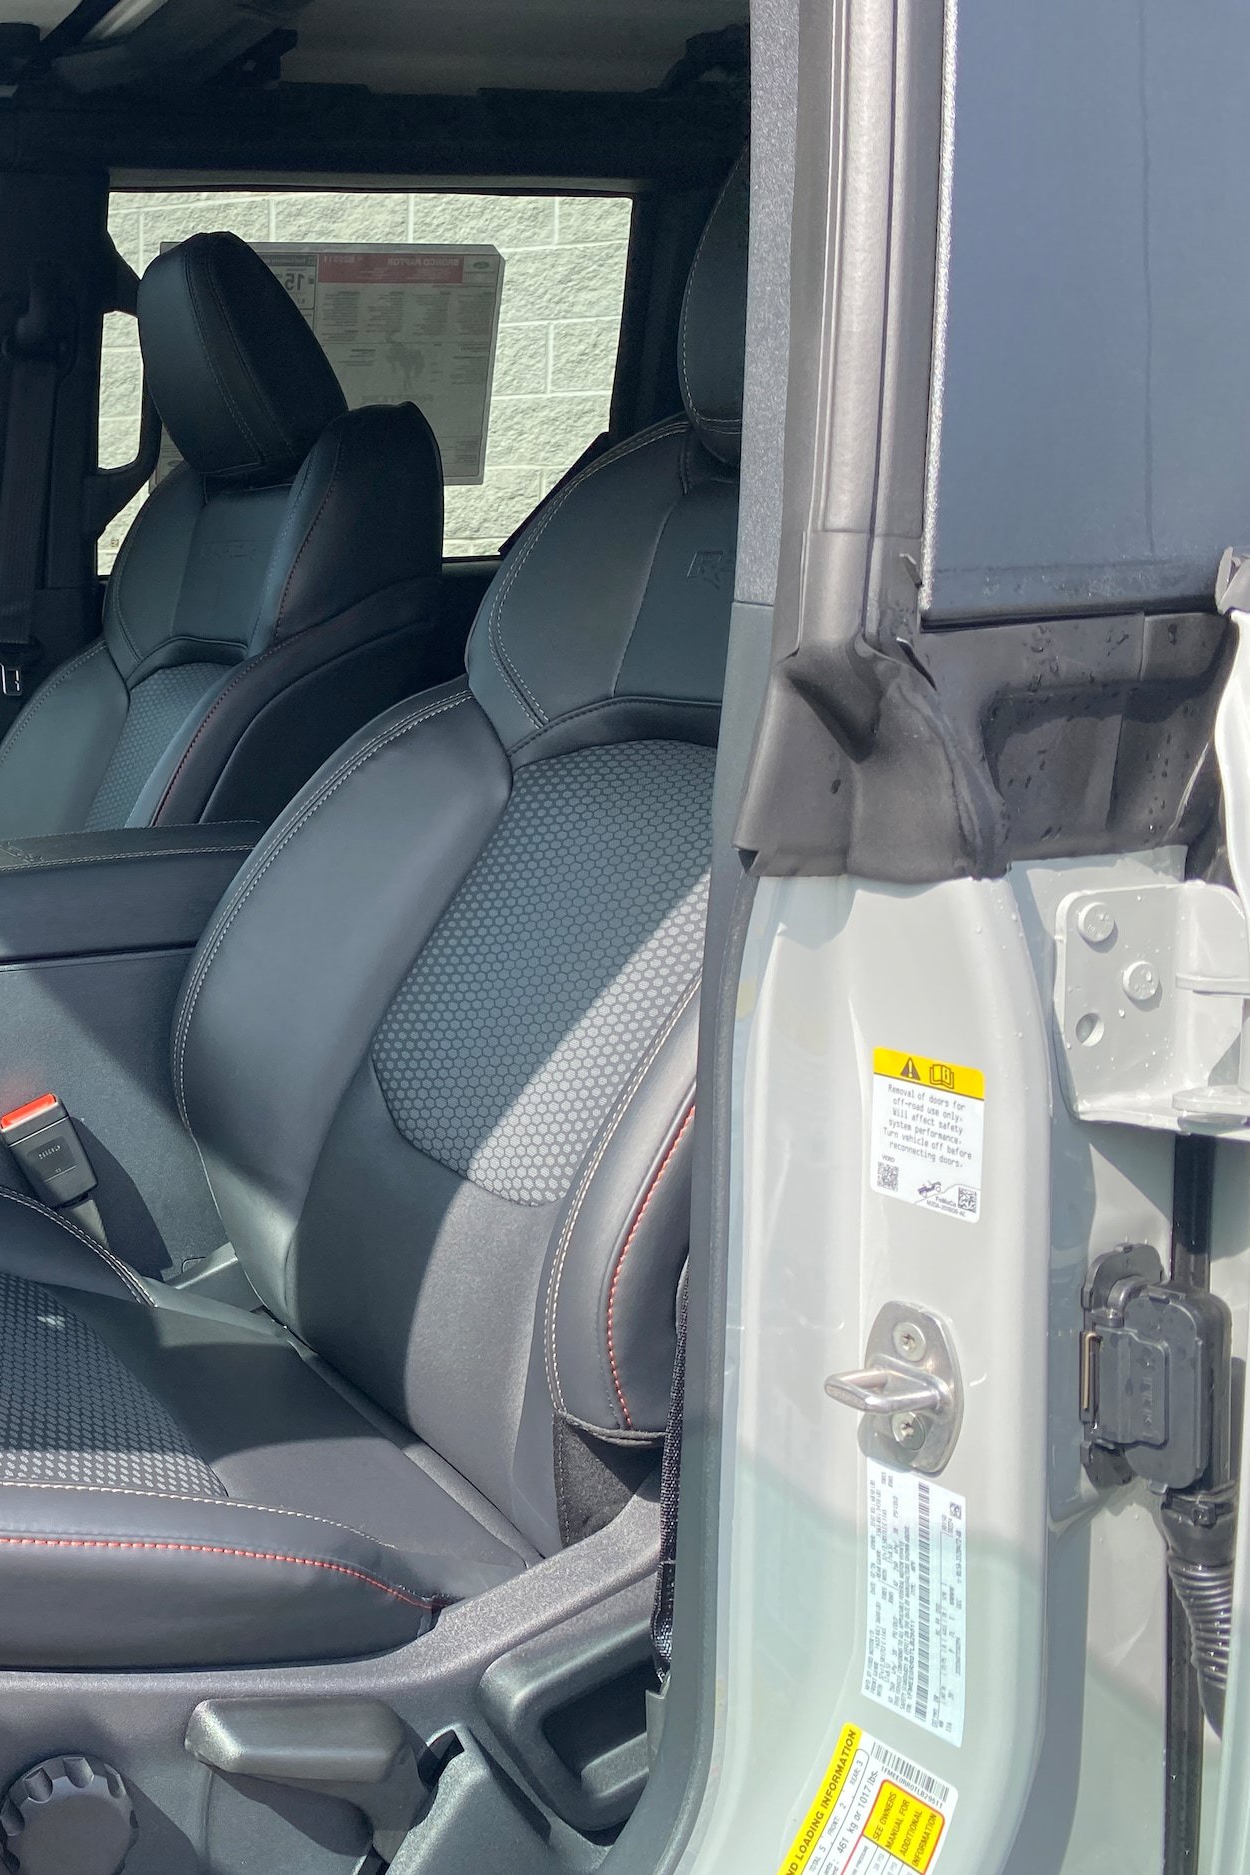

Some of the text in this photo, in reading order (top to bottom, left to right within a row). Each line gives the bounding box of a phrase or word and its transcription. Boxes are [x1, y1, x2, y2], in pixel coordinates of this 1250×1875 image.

[888, 1084, 965, 1111] Removal of doors for
[893, 1098, 963, 1124] off-road use only.
[889, 1119, 962, 1146] system performance.
[892, 1108, 963, 1135] Will affect safety
[883, 1127, 972, 1160] Turn vehicle off before
[890, 1141, 963, 1168] reconnecting doors.
[795, 1811, 824, 1860] LOADING
[821, 1729, 856, 1809] INFORMATION
[839, 1802, 847, 1810] 2
[837, 1771, 879, 1854] 461 kg or 1017 lbs.
[872, 1791, 897, 1841] SEE OWNERS
[885, 1799, 910, 1849] MANUAL FOR
[900, 1810, 922, 1856] ADDITIONAL
[912, 1813, 938, 1867] INFORMATION
